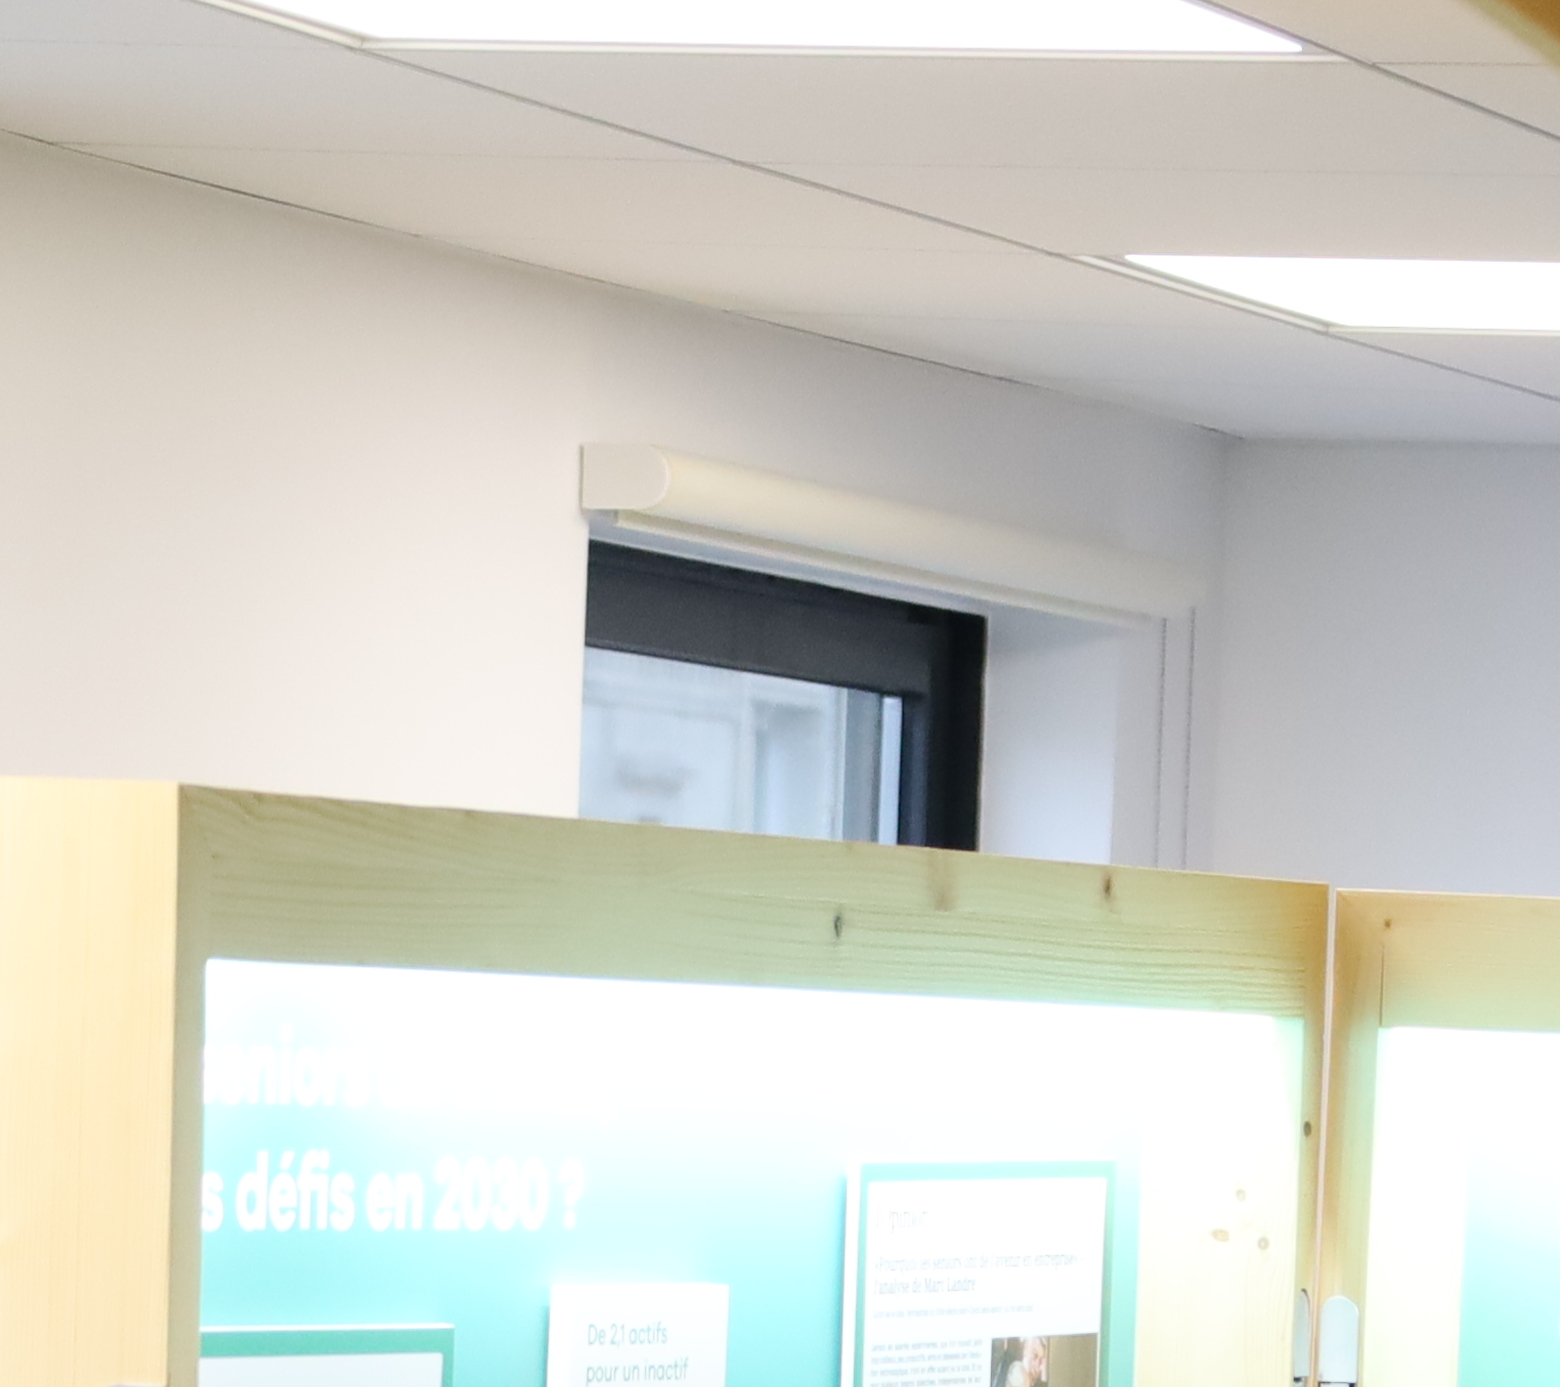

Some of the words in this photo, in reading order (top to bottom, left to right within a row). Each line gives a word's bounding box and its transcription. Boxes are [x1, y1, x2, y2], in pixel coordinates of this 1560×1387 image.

[235, 1148, 356, 1232] défis
[365, 1171, 424, 1232] en
[432, 1156, 550, 1232] 2030
[587, 1323, 606, 1346] De
[609, 1322, 625, 1347] 2,1
[628, 1321, 667, 1345] actifs
[584, 1365, 619, 1387] pour
[622, 1364, 640, 1382] un
[643, 1357, 688, 1381] inactif
